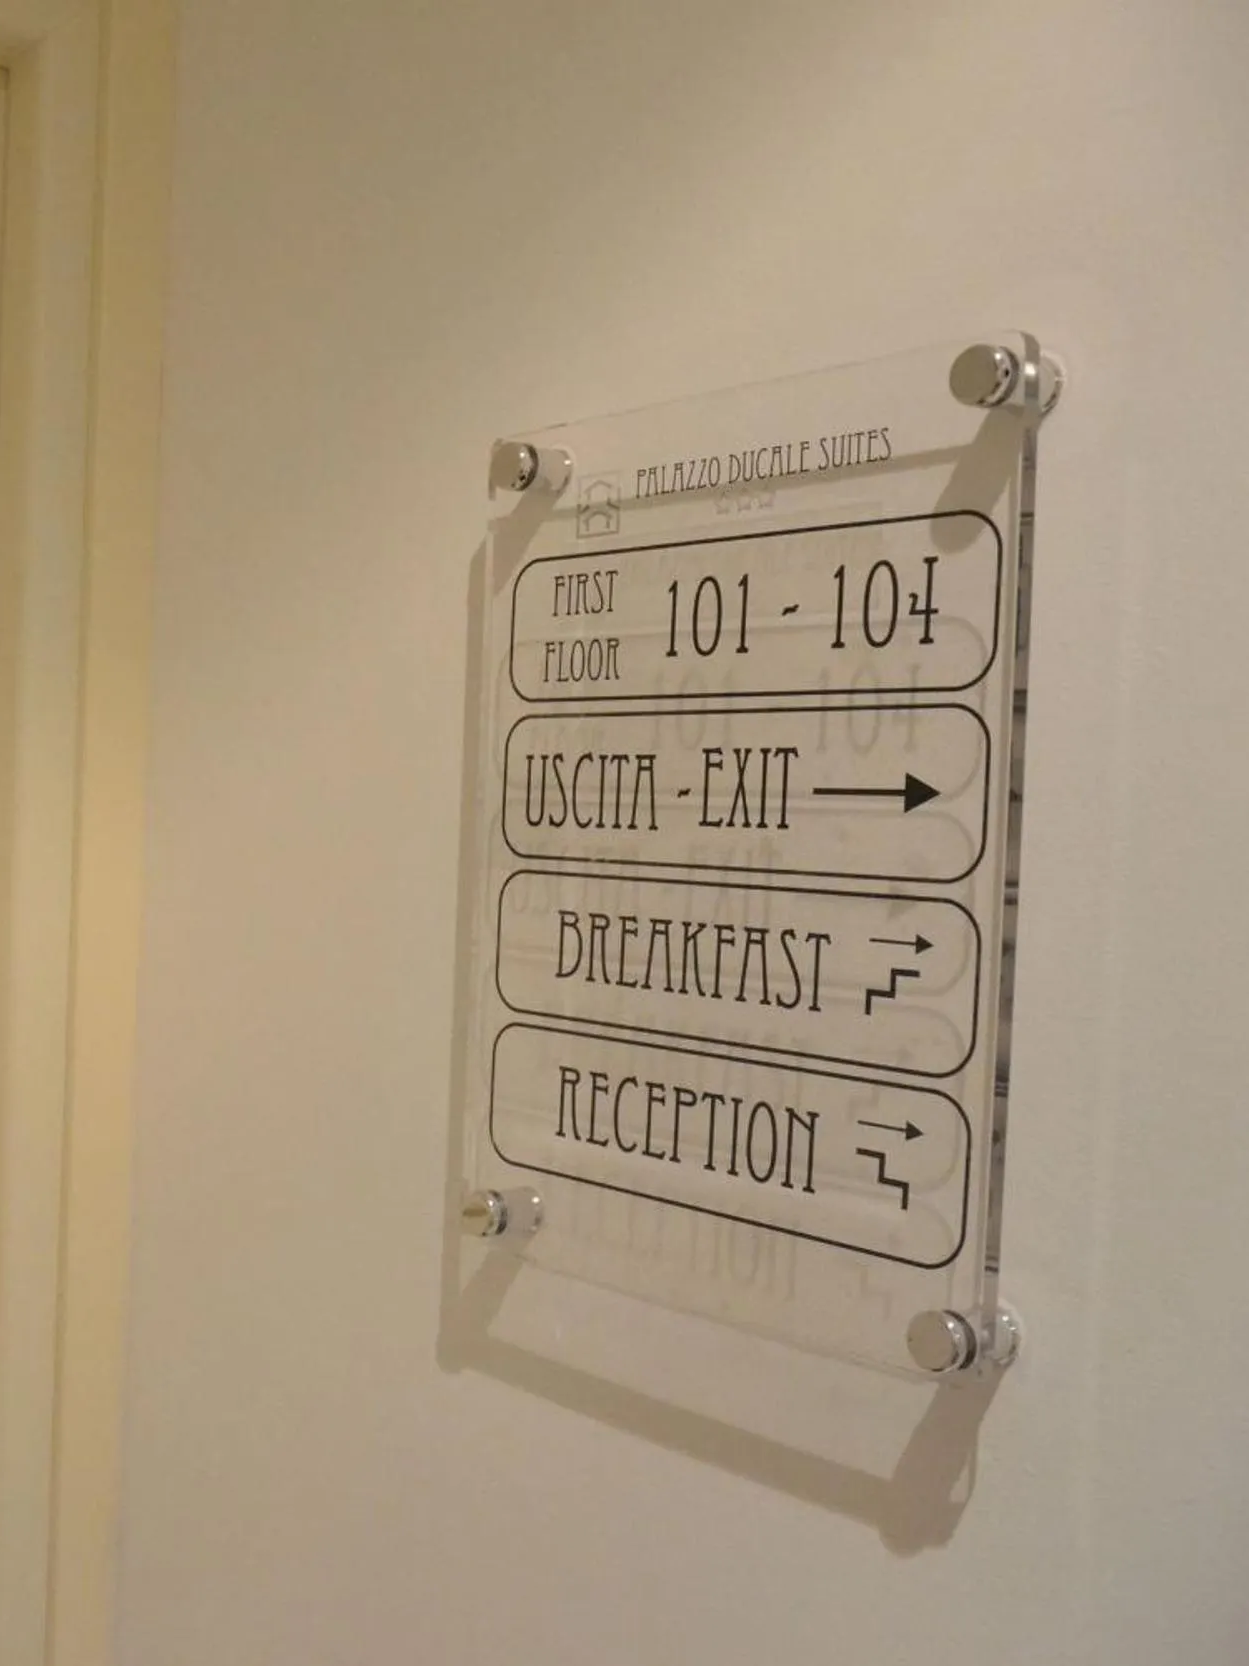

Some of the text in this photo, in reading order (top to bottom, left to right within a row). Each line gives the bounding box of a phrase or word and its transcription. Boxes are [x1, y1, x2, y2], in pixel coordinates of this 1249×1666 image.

[635, 427, 892, 499] PALAZZO DUCALE SUITES
[551, 569, 619, 617] FIRST
[665, 573, 750, 657] 101
[831, 555, 939, 649] 104
[542, 637, 620, 682] FLOOR
[524, 753, 658, 831] USCITA
[698, 747, 798, 829] EXIT
[555, 909, 831, 1013] BREAKFAST
[555, 1065, 820, 1194] RECEPTION
